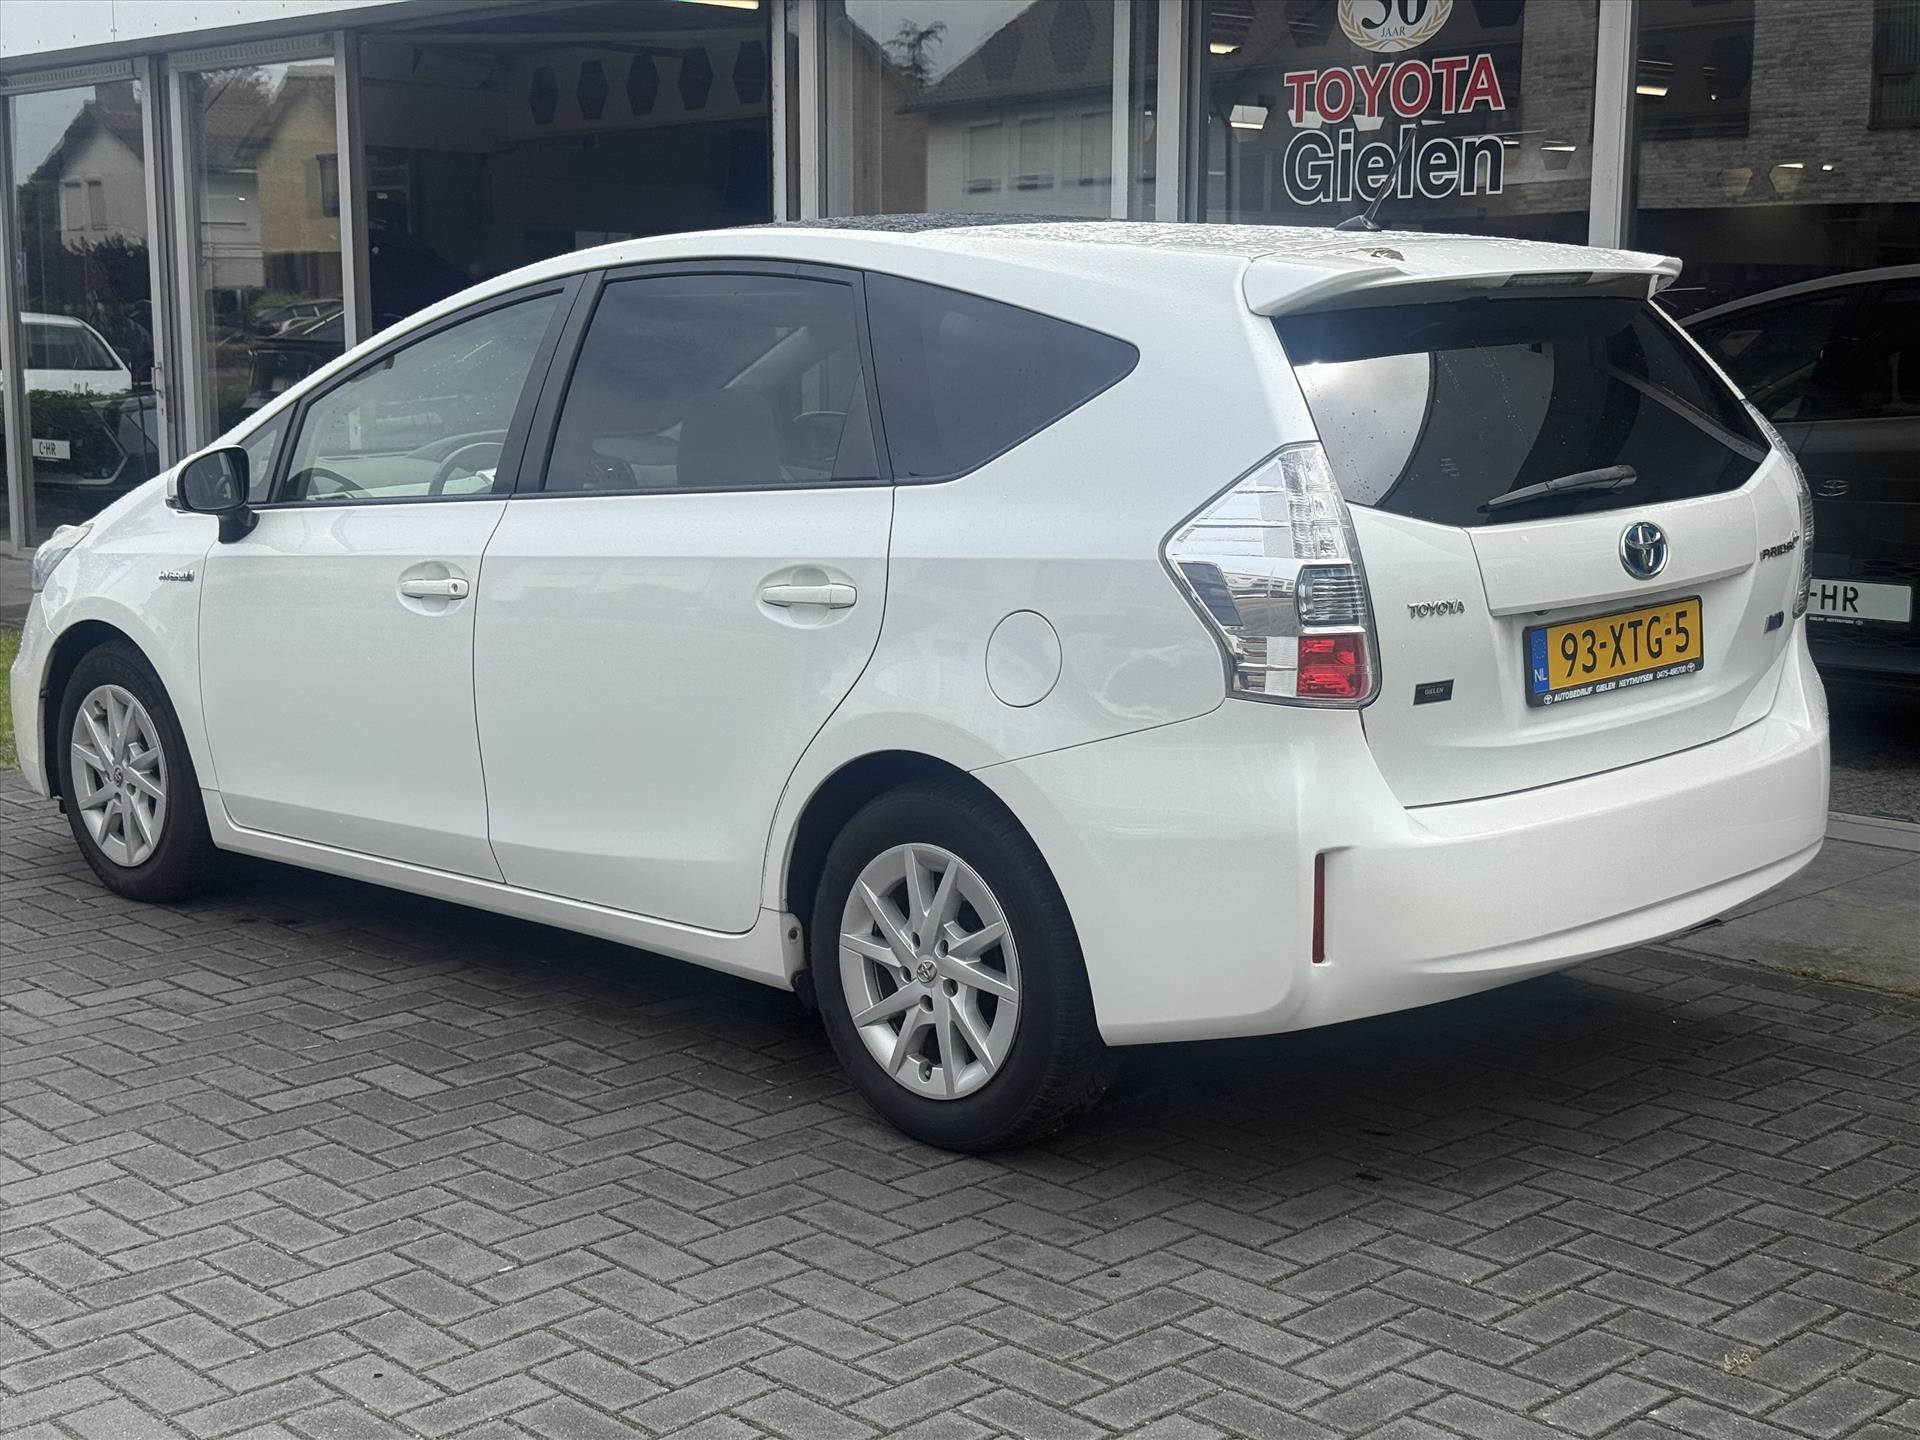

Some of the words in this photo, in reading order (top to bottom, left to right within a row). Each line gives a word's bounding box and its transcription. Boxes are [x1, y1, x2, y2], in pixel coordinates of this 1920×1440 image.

[1381, 26, 1406, 38] JAAR
[1284, 53, 1506, 124] TOYOTA
[1283, 123, 1505, 206] Gielen
[40, 441, 56, 456] C-HR
[1407, 600, 1465, 619] TOYOTA
[1809, 584, 1859, 613] -HR
[1560, 610, 1690, 678] 93-XTG-5
[1534, 669, 1548, 682] NL
[1554, 686, 1593, 702] AUTOBEDRIJF
[1595, 681, 1616, 693] GIELEN
[1618, 672, 1653, 688] HEYTHUYSEN
